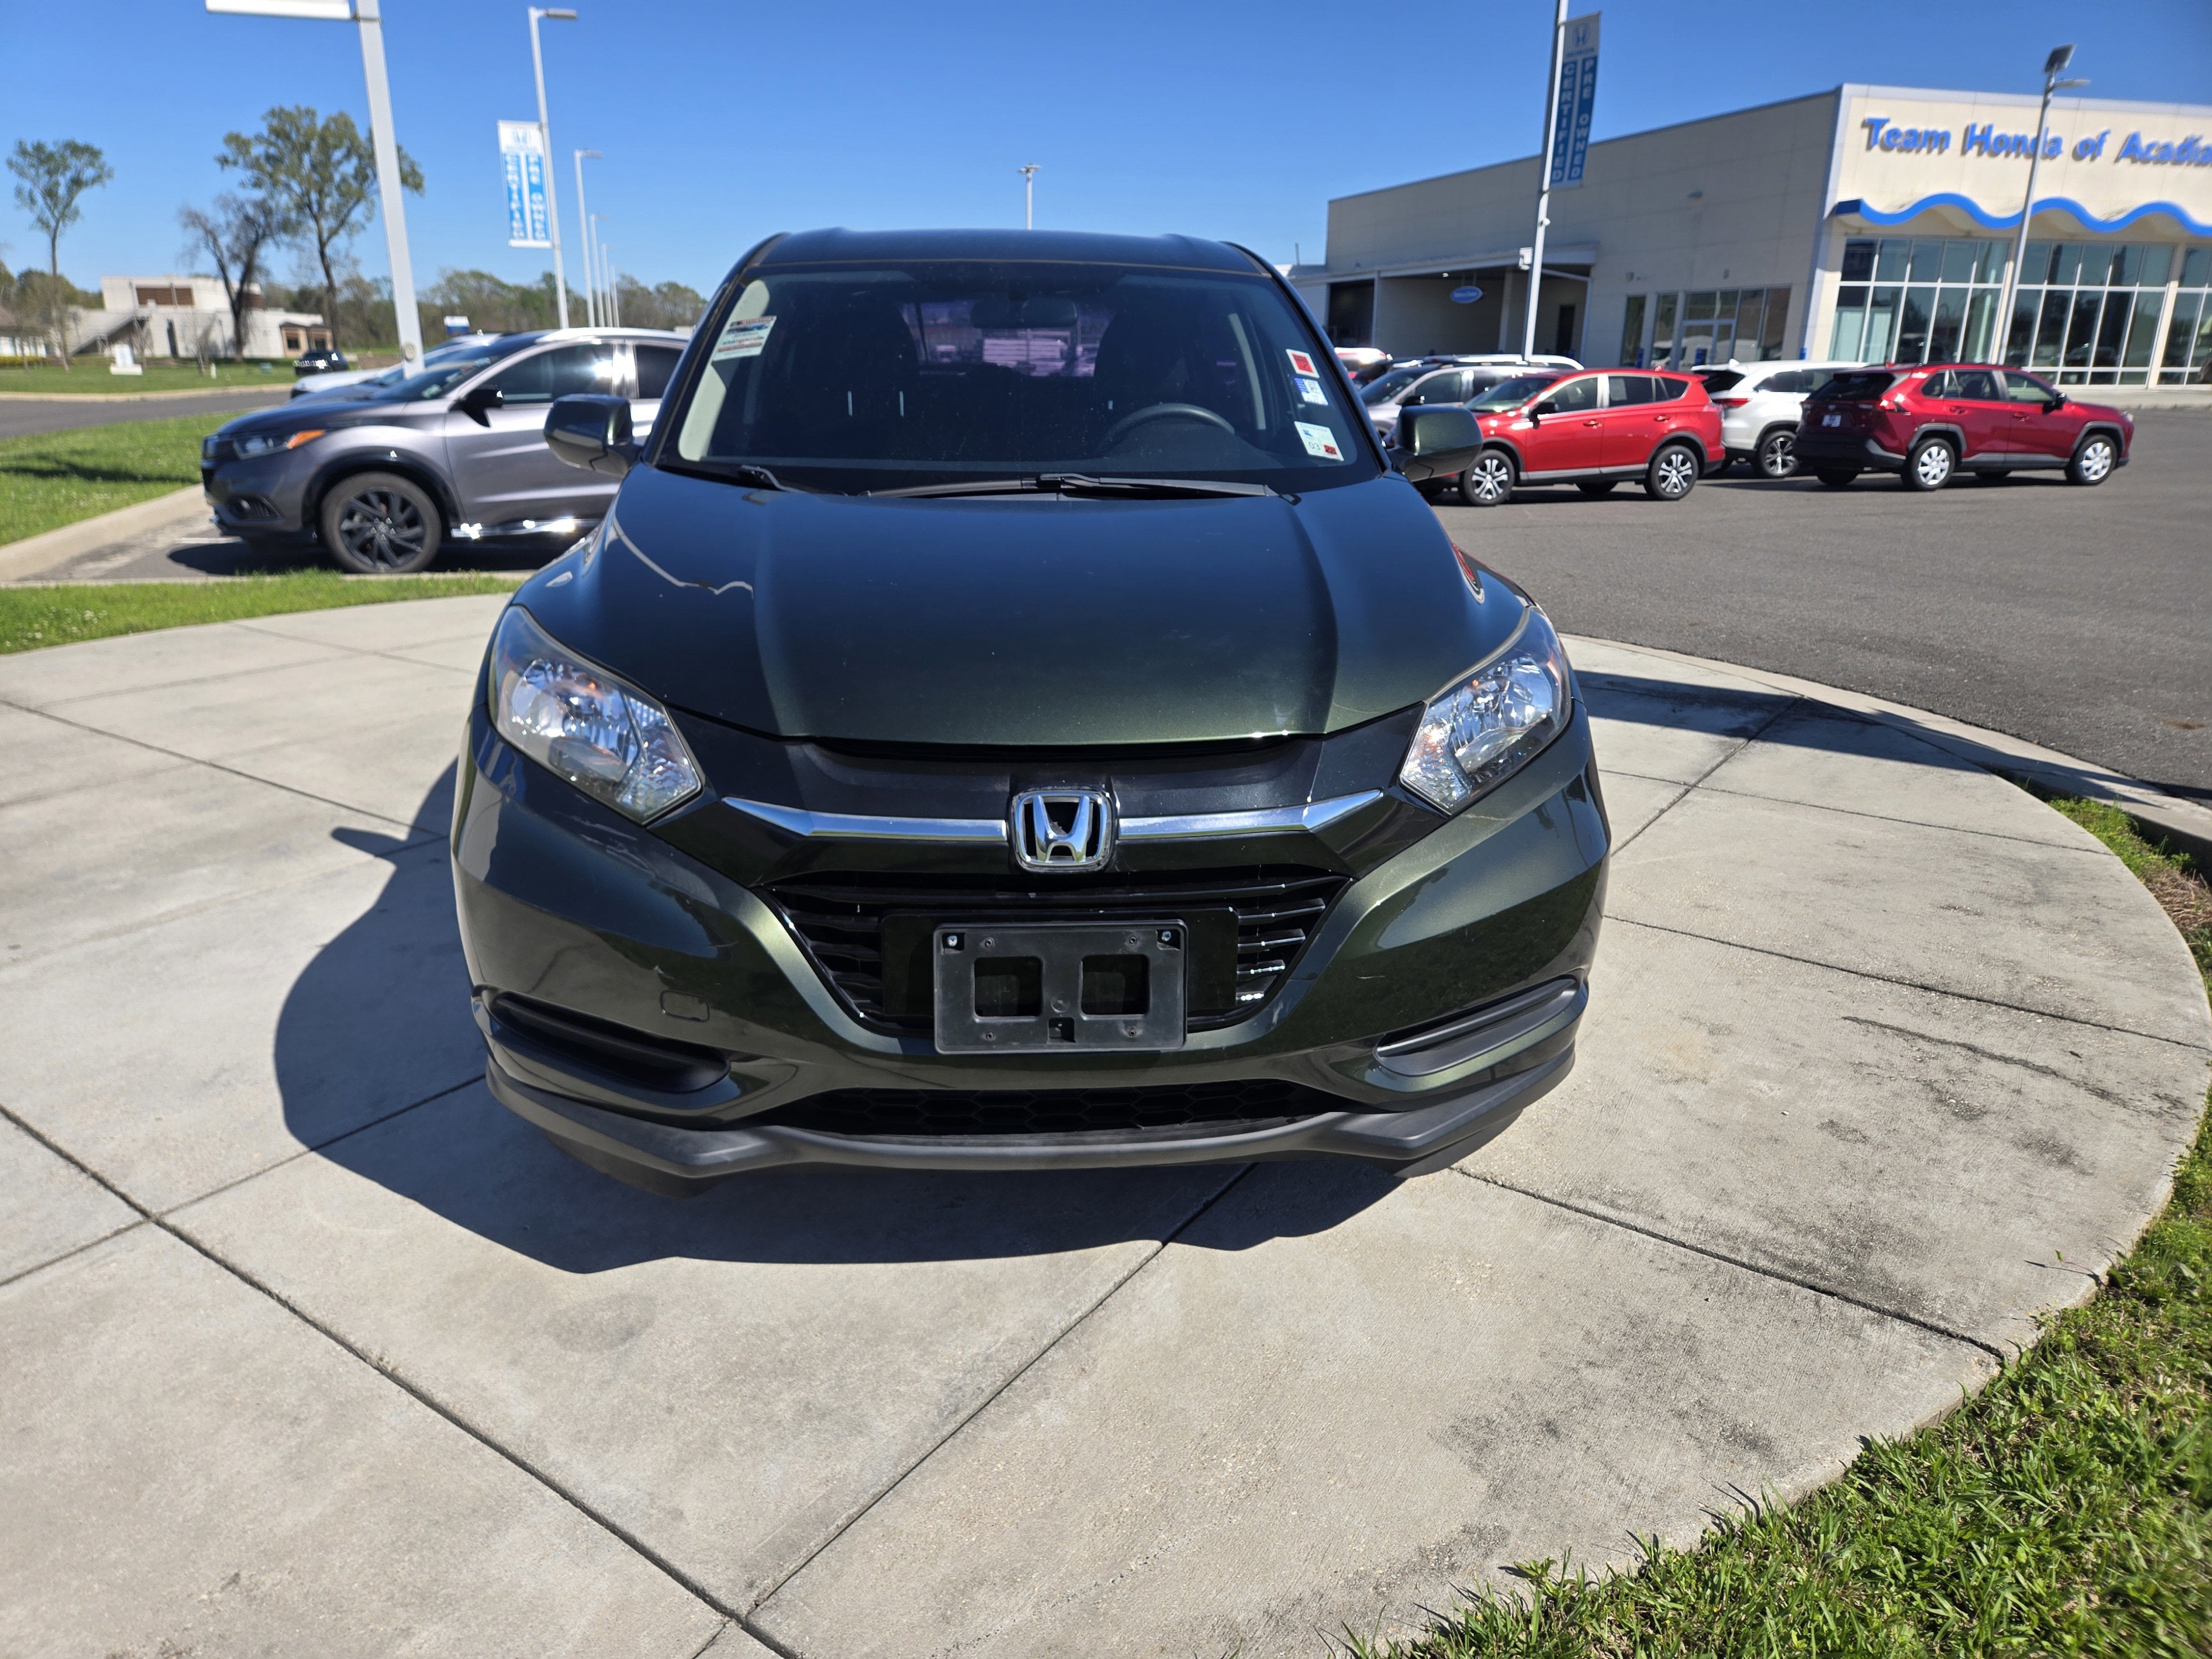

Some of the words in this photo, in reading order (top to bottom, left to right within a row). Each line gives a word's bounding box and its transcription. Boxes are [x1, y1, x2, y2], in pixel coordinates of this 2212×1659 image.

[1582, 58, 1595, 100] PRE
[1865, 118, 1951, 150] Team
[2078, 129, 2112, 156] of
